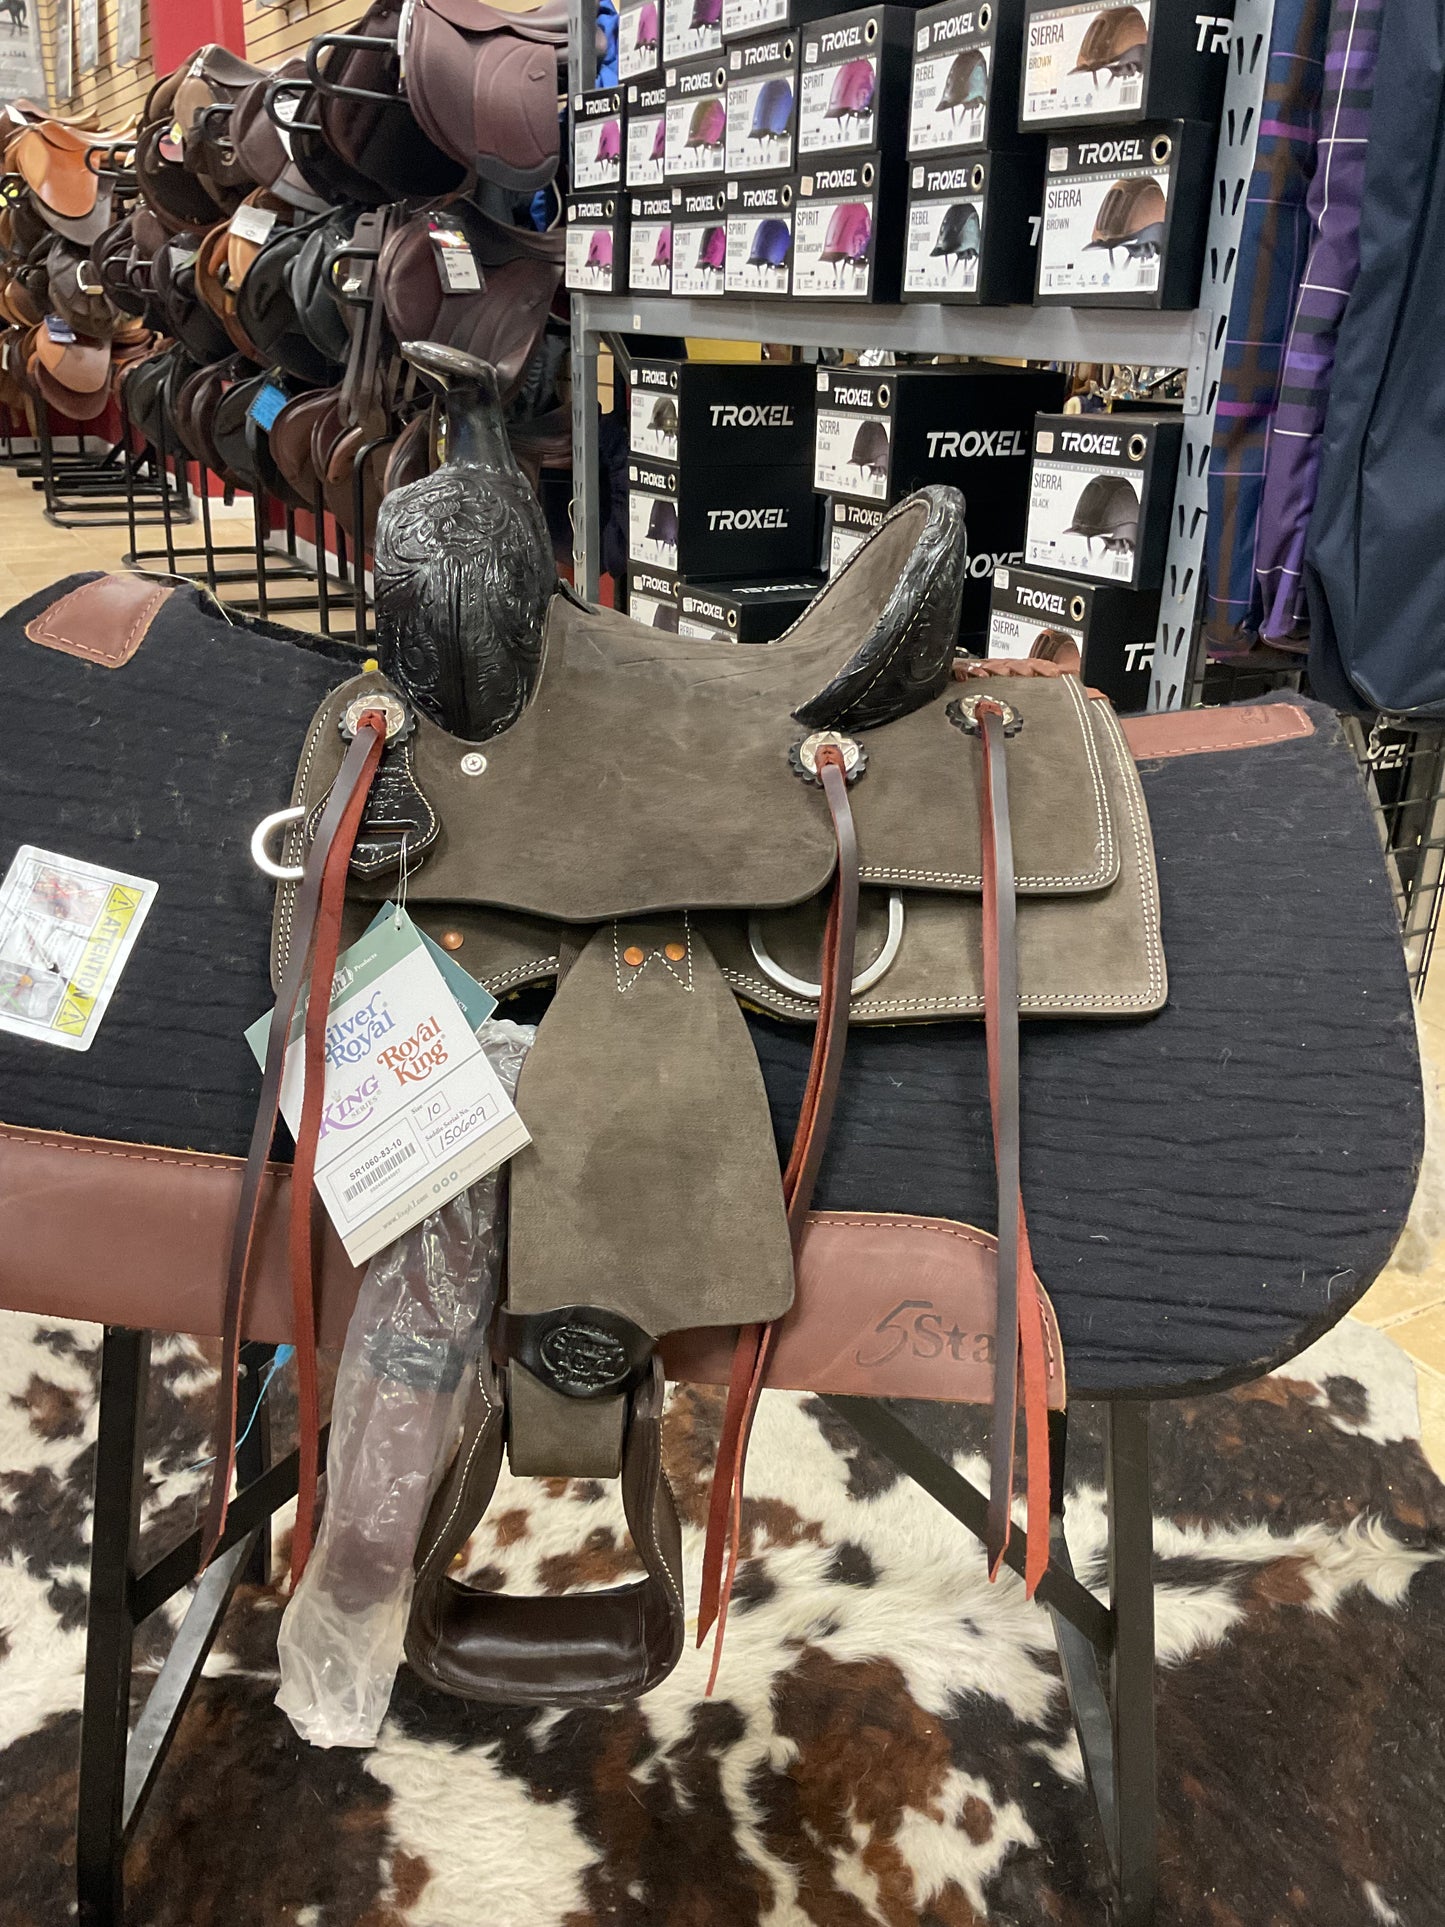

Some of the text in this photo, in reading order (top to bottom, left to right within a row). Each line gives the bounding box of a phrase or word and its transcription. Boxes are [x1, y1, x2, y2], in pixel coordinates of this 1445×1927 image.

[933, 12, 975, 42] TROXEL
[1030, 23, 1064, 46] SIERRA
[821, 26, 861, 52] TROXEL
[745, 42, 781, 65] TROXEL
[1028, 55, 1052, 70] BROWN
[680, 72, 712, 92] TROXEL
[803, 73, 824, 90] SPIRIT
[586, 98, 611, 114] TROXEL
[641, 88, 666, 107] TROXE
[729, 89, 748, 106] SPIRIT
[1078, 139, 1143, 165] TROXEL
[816, 169, 857, 189] TROXEL
[927, 169, 967, 191] TROXEL
[643, 200, 672, 215] TROXEL
[686, 195, 715, 212] TROXEL
[743, 189, 778, 207] TROXEL
[1048, 189, 1081, 208] SIERRA
[578, 203, 603, 217] TROXEL
[797, 210, 819, 227] SPIRIT
[911, 210, 929, 225] REBEL
[728, 223, 747, 235] SPIRIT
[1046, 218, 1070, 231] BROWN
[642, 369, 668, 386] TROXEL
[834, 387, 873, 407] TROXEL
[709, 405, 794, 427] TROXEL
[818, 419, 840, 435] SIERRA
[926, 430, 1026, 458] TROXEL
[1061, 431, 1121, 456] TROXEL
[640, 471, 667, 489] TROXEL
[1034, 472, 1062, 491] SIERRA
[1031, 497, 1049, 509] BLACK
[707, 508, 788, 531] TROXEL
[964, 551, 1024, 579] OXE
[642, 574, 671, 594] TROXEL
[692, 599, 724, 620] TROXEL
[1016, 586, 1066, 615] TROXEL
[992, 619, 1020, 637] SIERRA
[991, 640, 1010, 651] BROWN
[73, 916, 122, 1000] ATTENTION
[330, 1009, 396, 1070] Royal
[376, 1015, 442, 1070] Royal
[393, 1039, 449, 1087] King
[351, 1096, 378, 1117] SERIES
[411, 1104, 423, 1114] Size
[427, 1102, 441, 1121] 10
[425, 1126, 444, 1141] Saddle
[443, 1113, 460, 1127] Serial
[439, 1106, 487, 1150] 150609
[349, 1138, 402, 1181] SR1060-83-10
[856, 1299, 997, 1368] 5Sta
